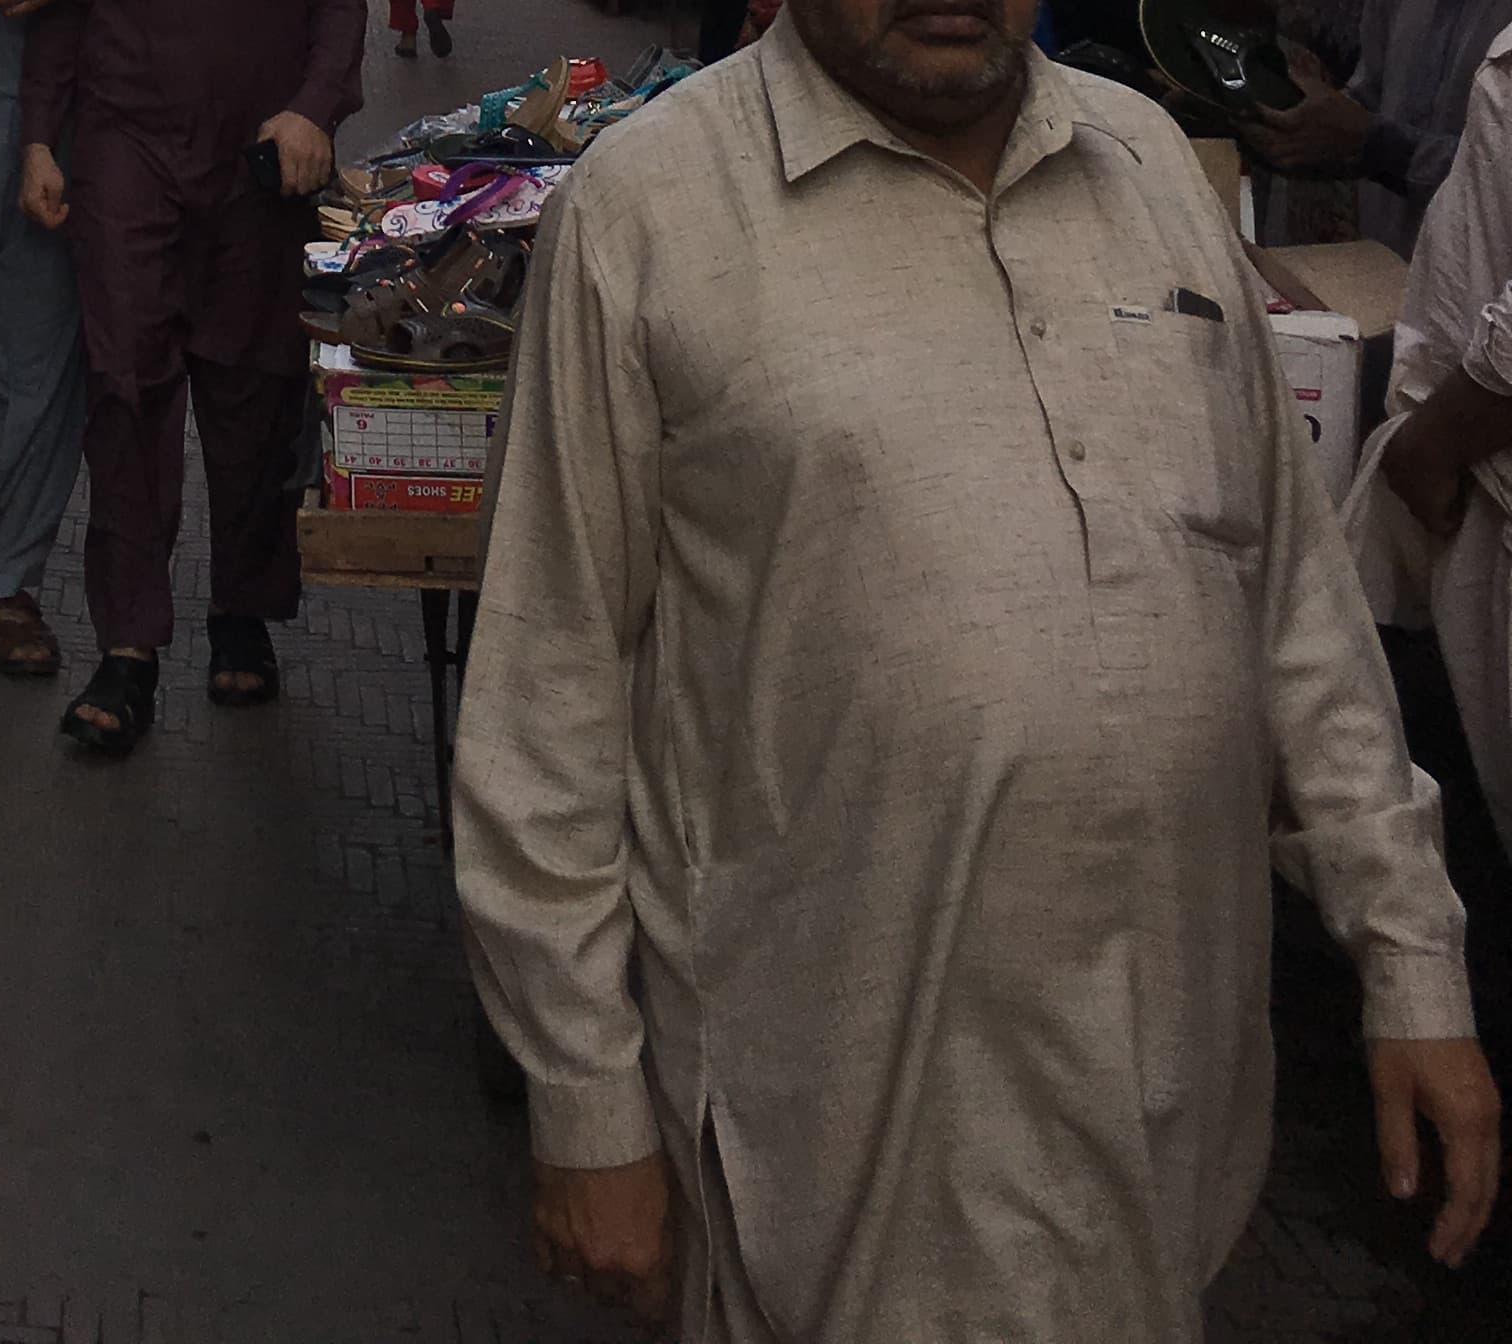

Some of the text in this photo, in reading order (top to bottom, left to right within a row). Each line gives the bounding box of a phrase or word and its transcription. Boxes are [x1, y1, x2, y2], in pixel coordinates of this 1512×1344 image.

[357, 419, 368, 430] 6
[344, 455, 357, 463] 41
[369, 457, 382, 465] 40
[393, 458, 406, 466] 39
[418, 458, 432, 467] 38
[443, 459, 456, 468] 37
[407, 485, 483, 502] EE SHOES
